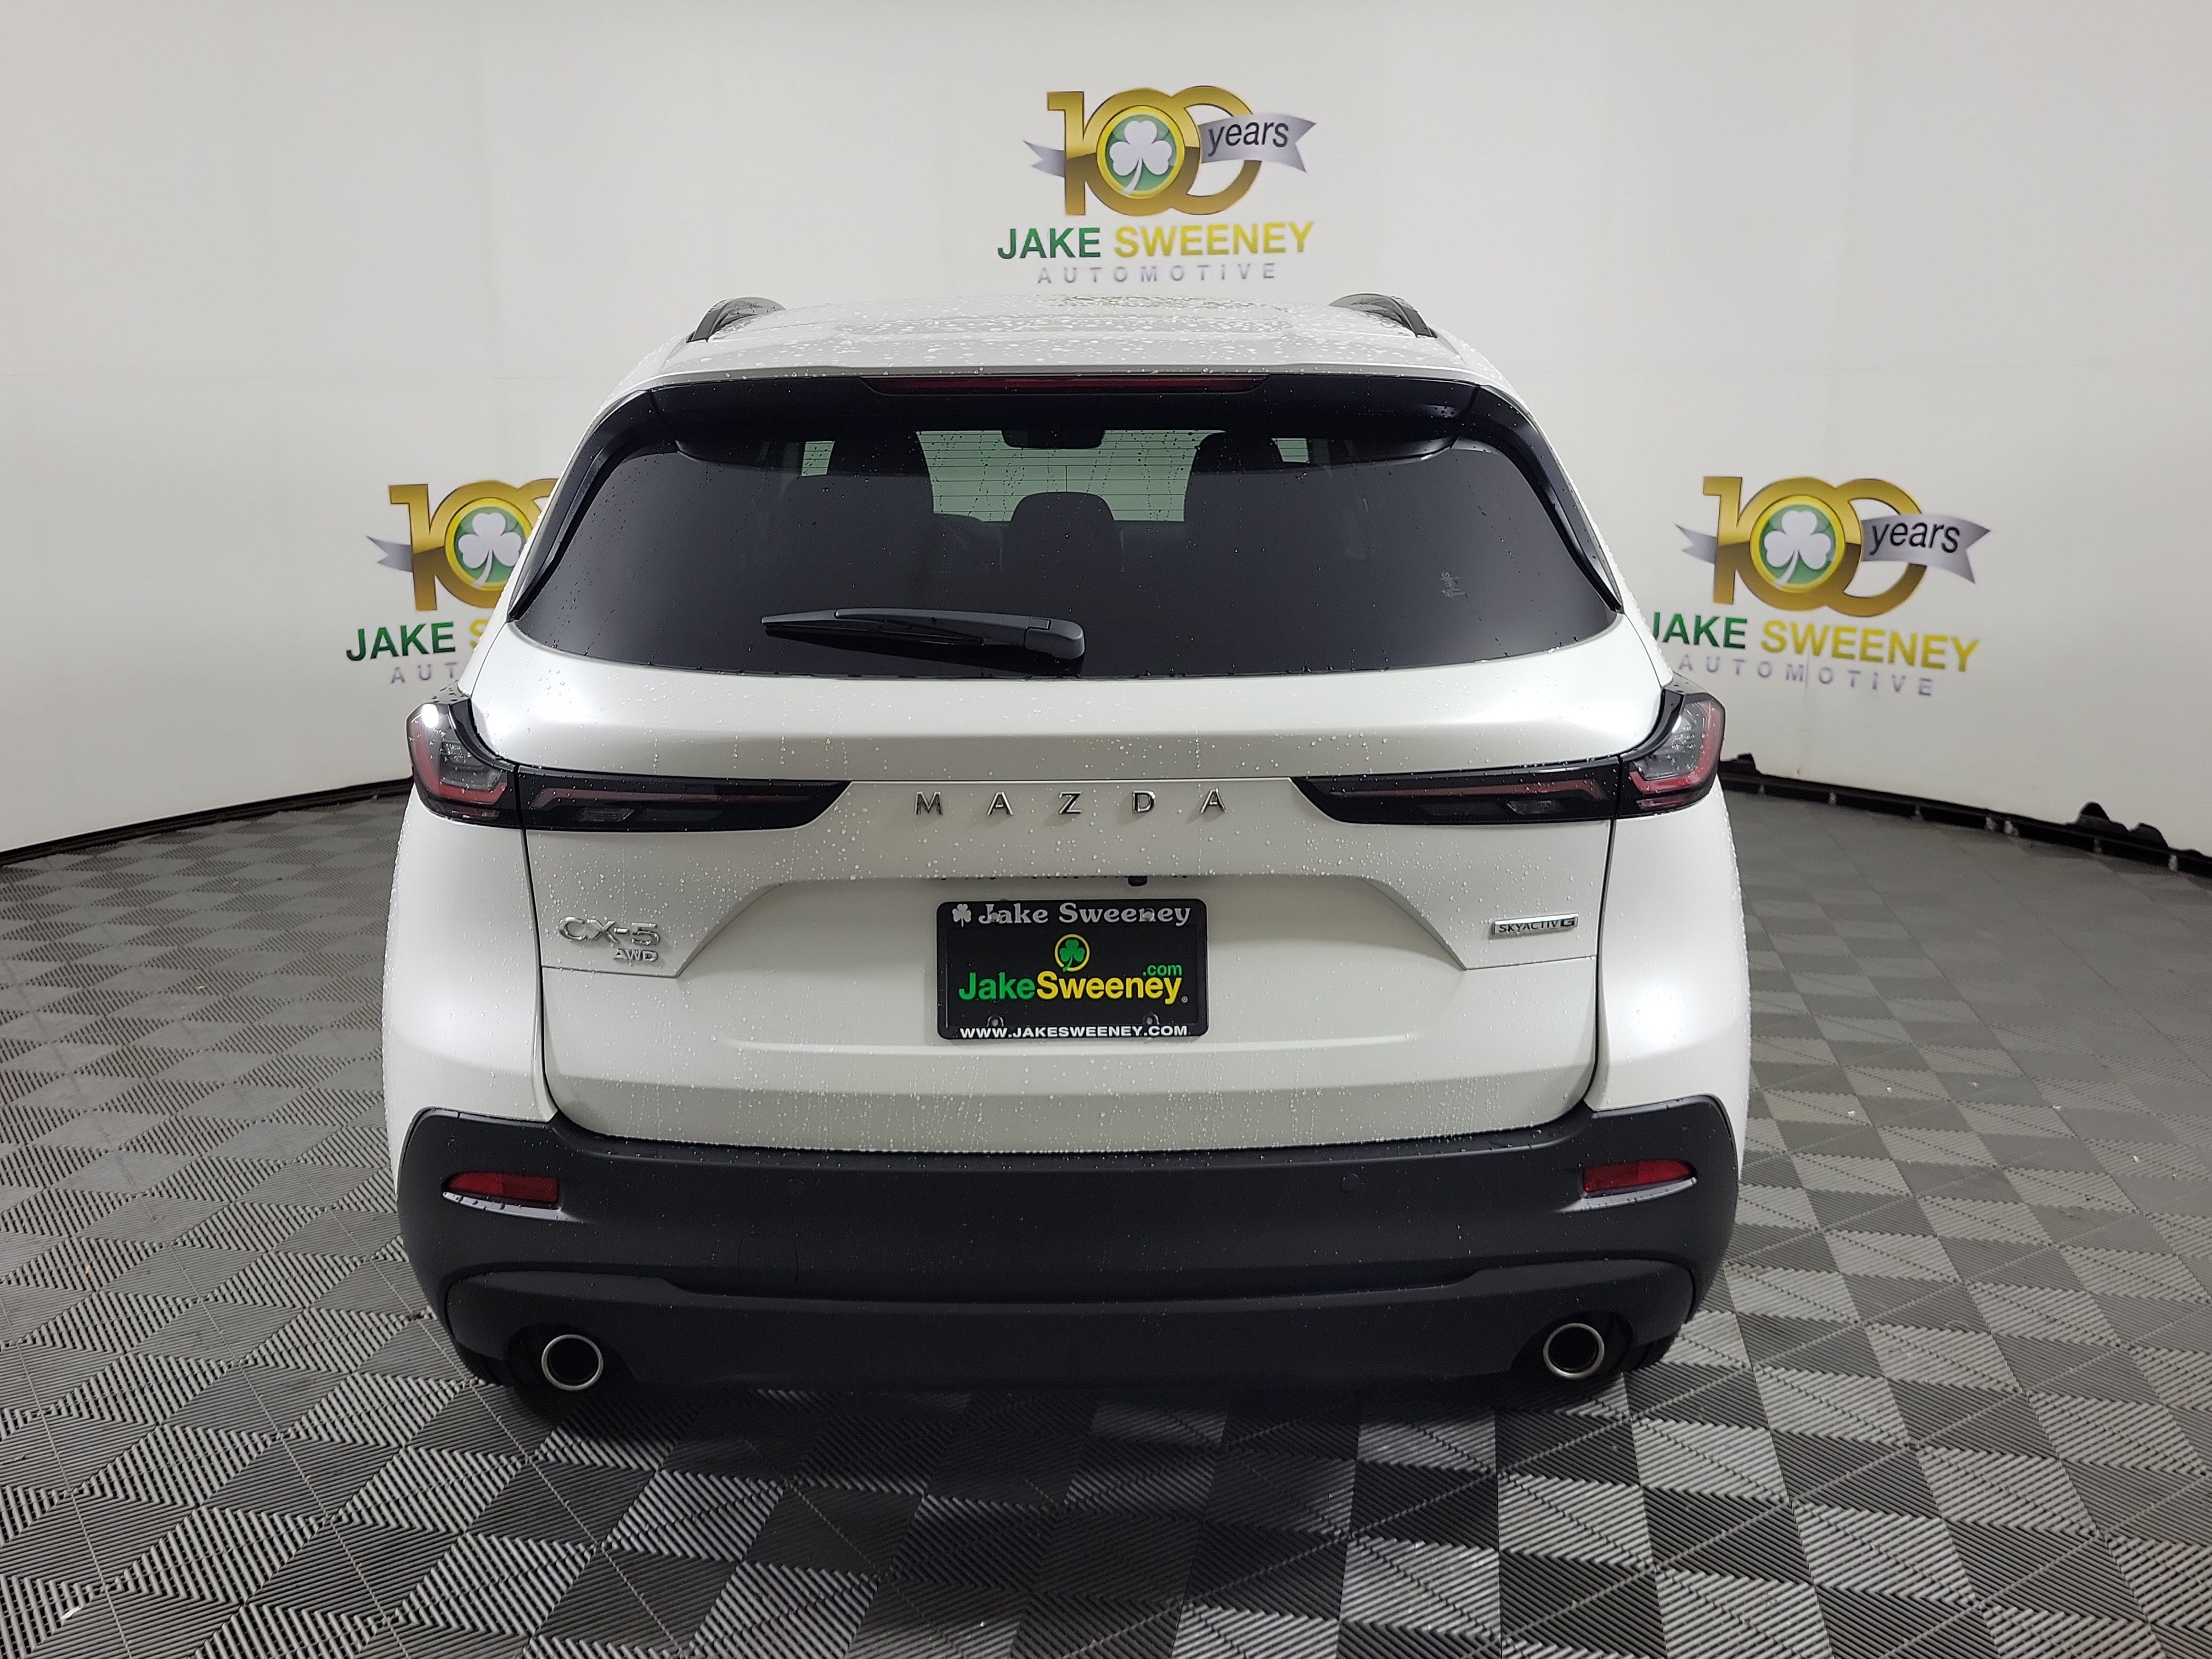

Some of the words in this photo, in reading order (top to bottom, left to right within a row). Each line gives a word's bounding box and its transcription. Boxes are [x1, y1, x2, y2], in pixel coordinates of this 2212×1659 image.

[1046, 86, 1262, 215] 100
[1207, 121, 1289, 157] years
[997, 227, 1101, 259] JAKE
[1114, 221, 1314, 258] SWEENEY
[1038, 263, 1276, 284] AUTOMOTIVE
[1702, 476, 1927, 617] 100
[1869, 522, 1961, 555] years
[346, 621, 456, 661] JAKE
[1760, 620, 1980, 672] SWEENEY
[1678, 653, 1933, 696] AUTOMOTIVE
[915, 788, 1227, 816] MAZDA
[558, 916, 661, 946] CX-5
[978, 903, 1048, 924] Jake
[1059, 902, 1191, 927] Sweeney
[614, 949, 658, 962] AWD
[960, 1025, 1188, 1039] WWW.JAKESWEENEY.COM
